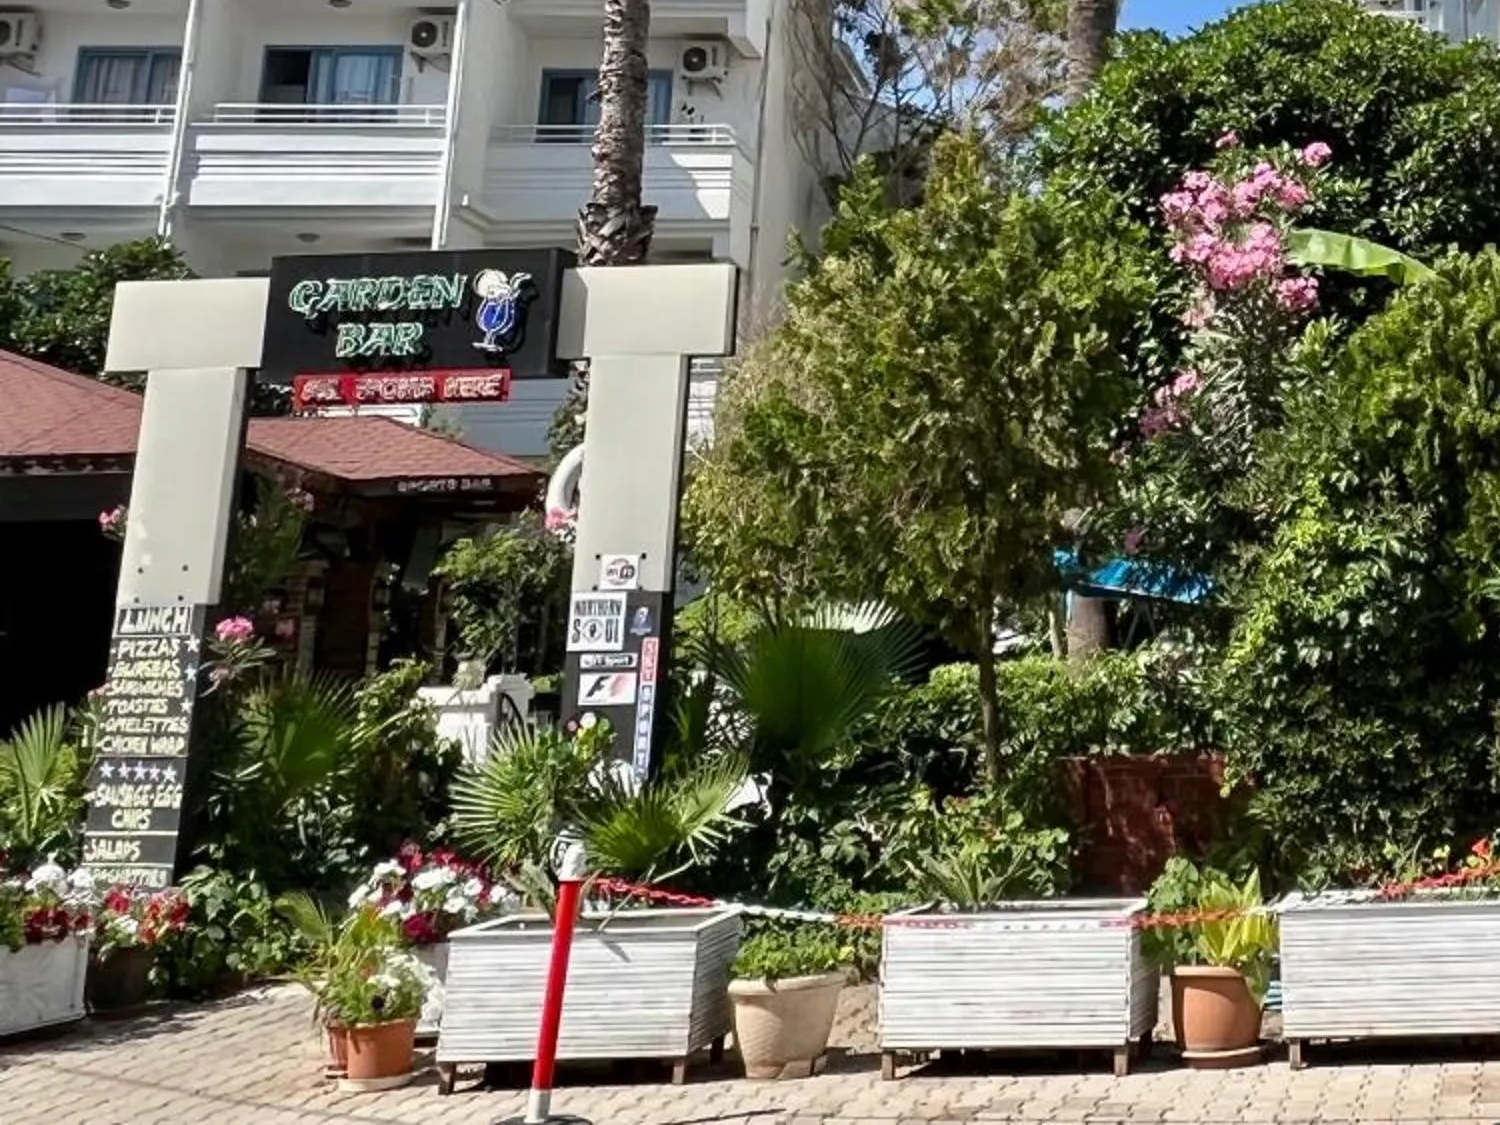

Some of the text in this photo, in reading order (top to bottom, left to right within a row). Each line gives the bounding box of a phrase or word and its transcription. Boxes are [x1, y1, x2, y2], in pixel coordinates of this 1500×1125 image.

[289, 274, 468, 319] GARDEN
[335, 322, 424, 357] BAR
[119, 606, 189, 634] LUNCH
[573, 598, 623, 617] NORTHERN
[117, 639, 180, 659] PIZZAS
